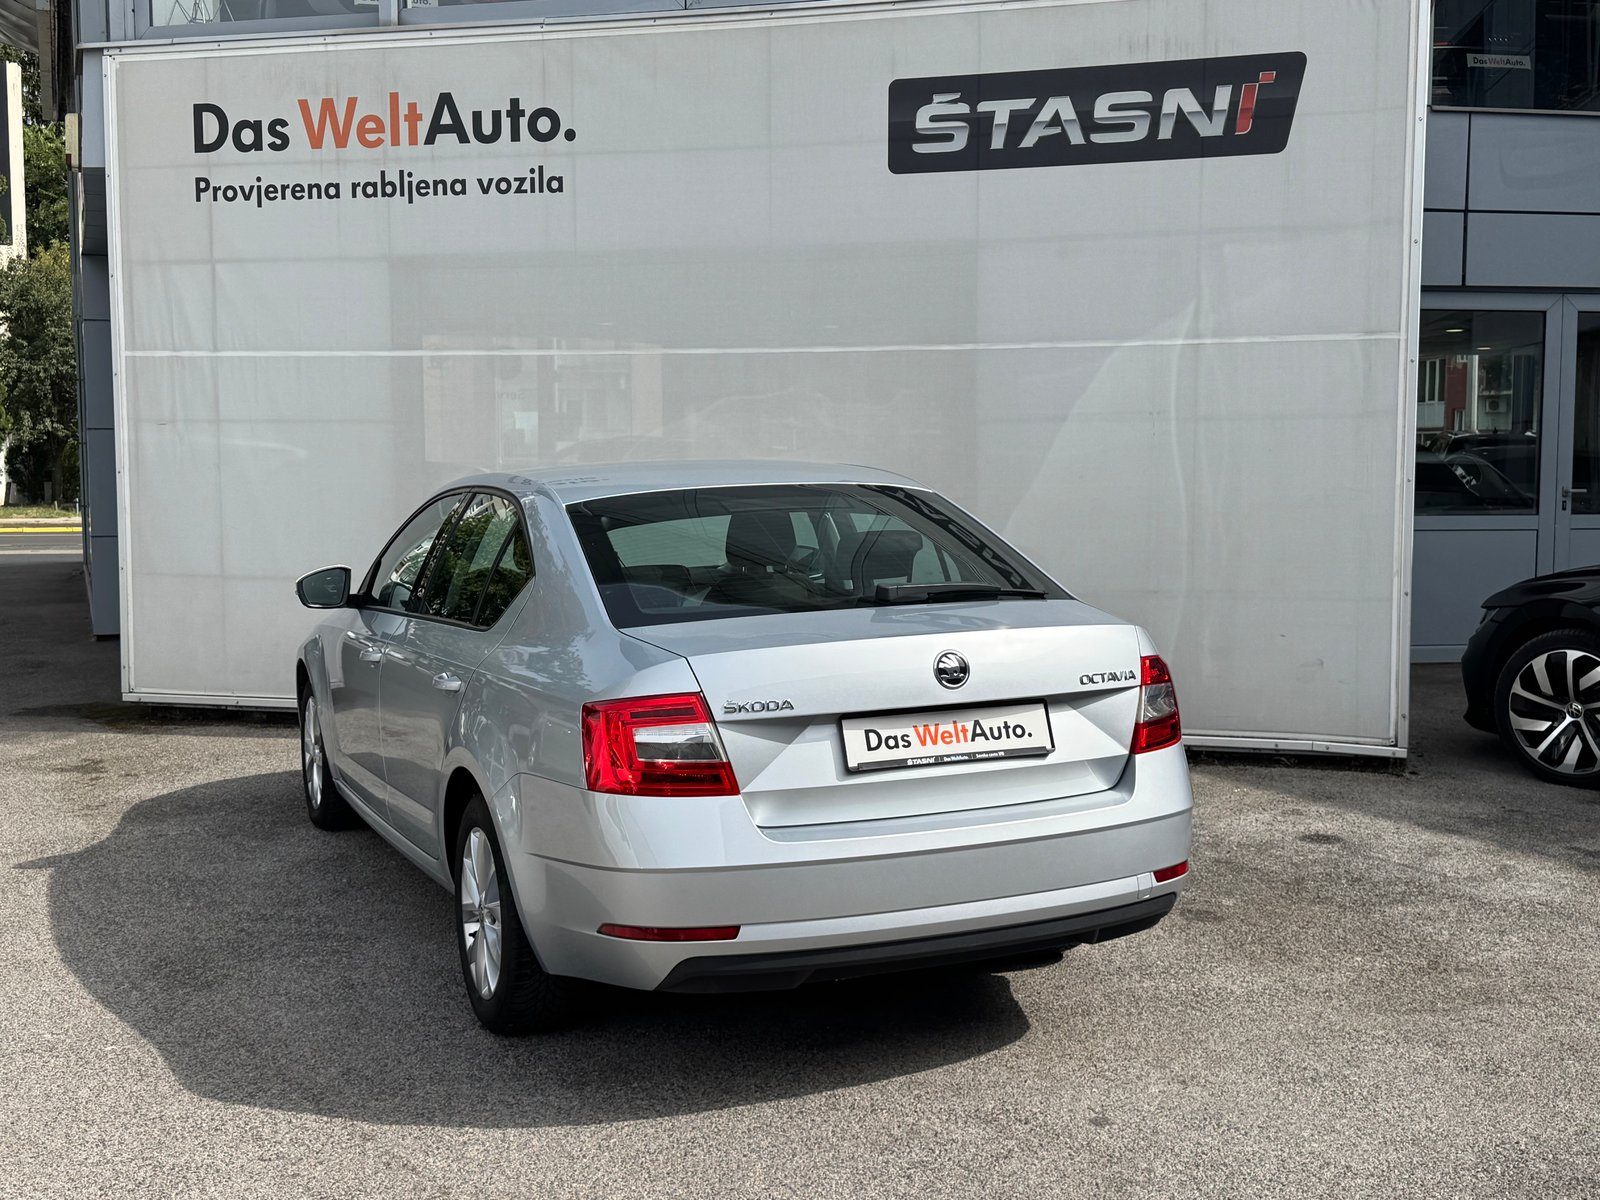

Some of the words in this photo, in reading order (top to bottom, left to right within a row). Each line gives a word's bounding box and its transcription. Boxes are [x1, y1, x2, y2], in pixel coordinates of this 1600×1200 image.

[193, 103, 290, 153] Das
[297, 92, 577, 150] WeltAuto.
[194, 176, 341, 208] Provjerena
[351, 169, 467, 204] rabljena
[476, 165, 564, 195] vozila
[1079, 670, 1137, 685] OCTAVIA
[723, 699, 795, 714] ŠKODA
[864, 728, 912, 751] Das
[912, 720, 1033, 747] WeltAuto.
